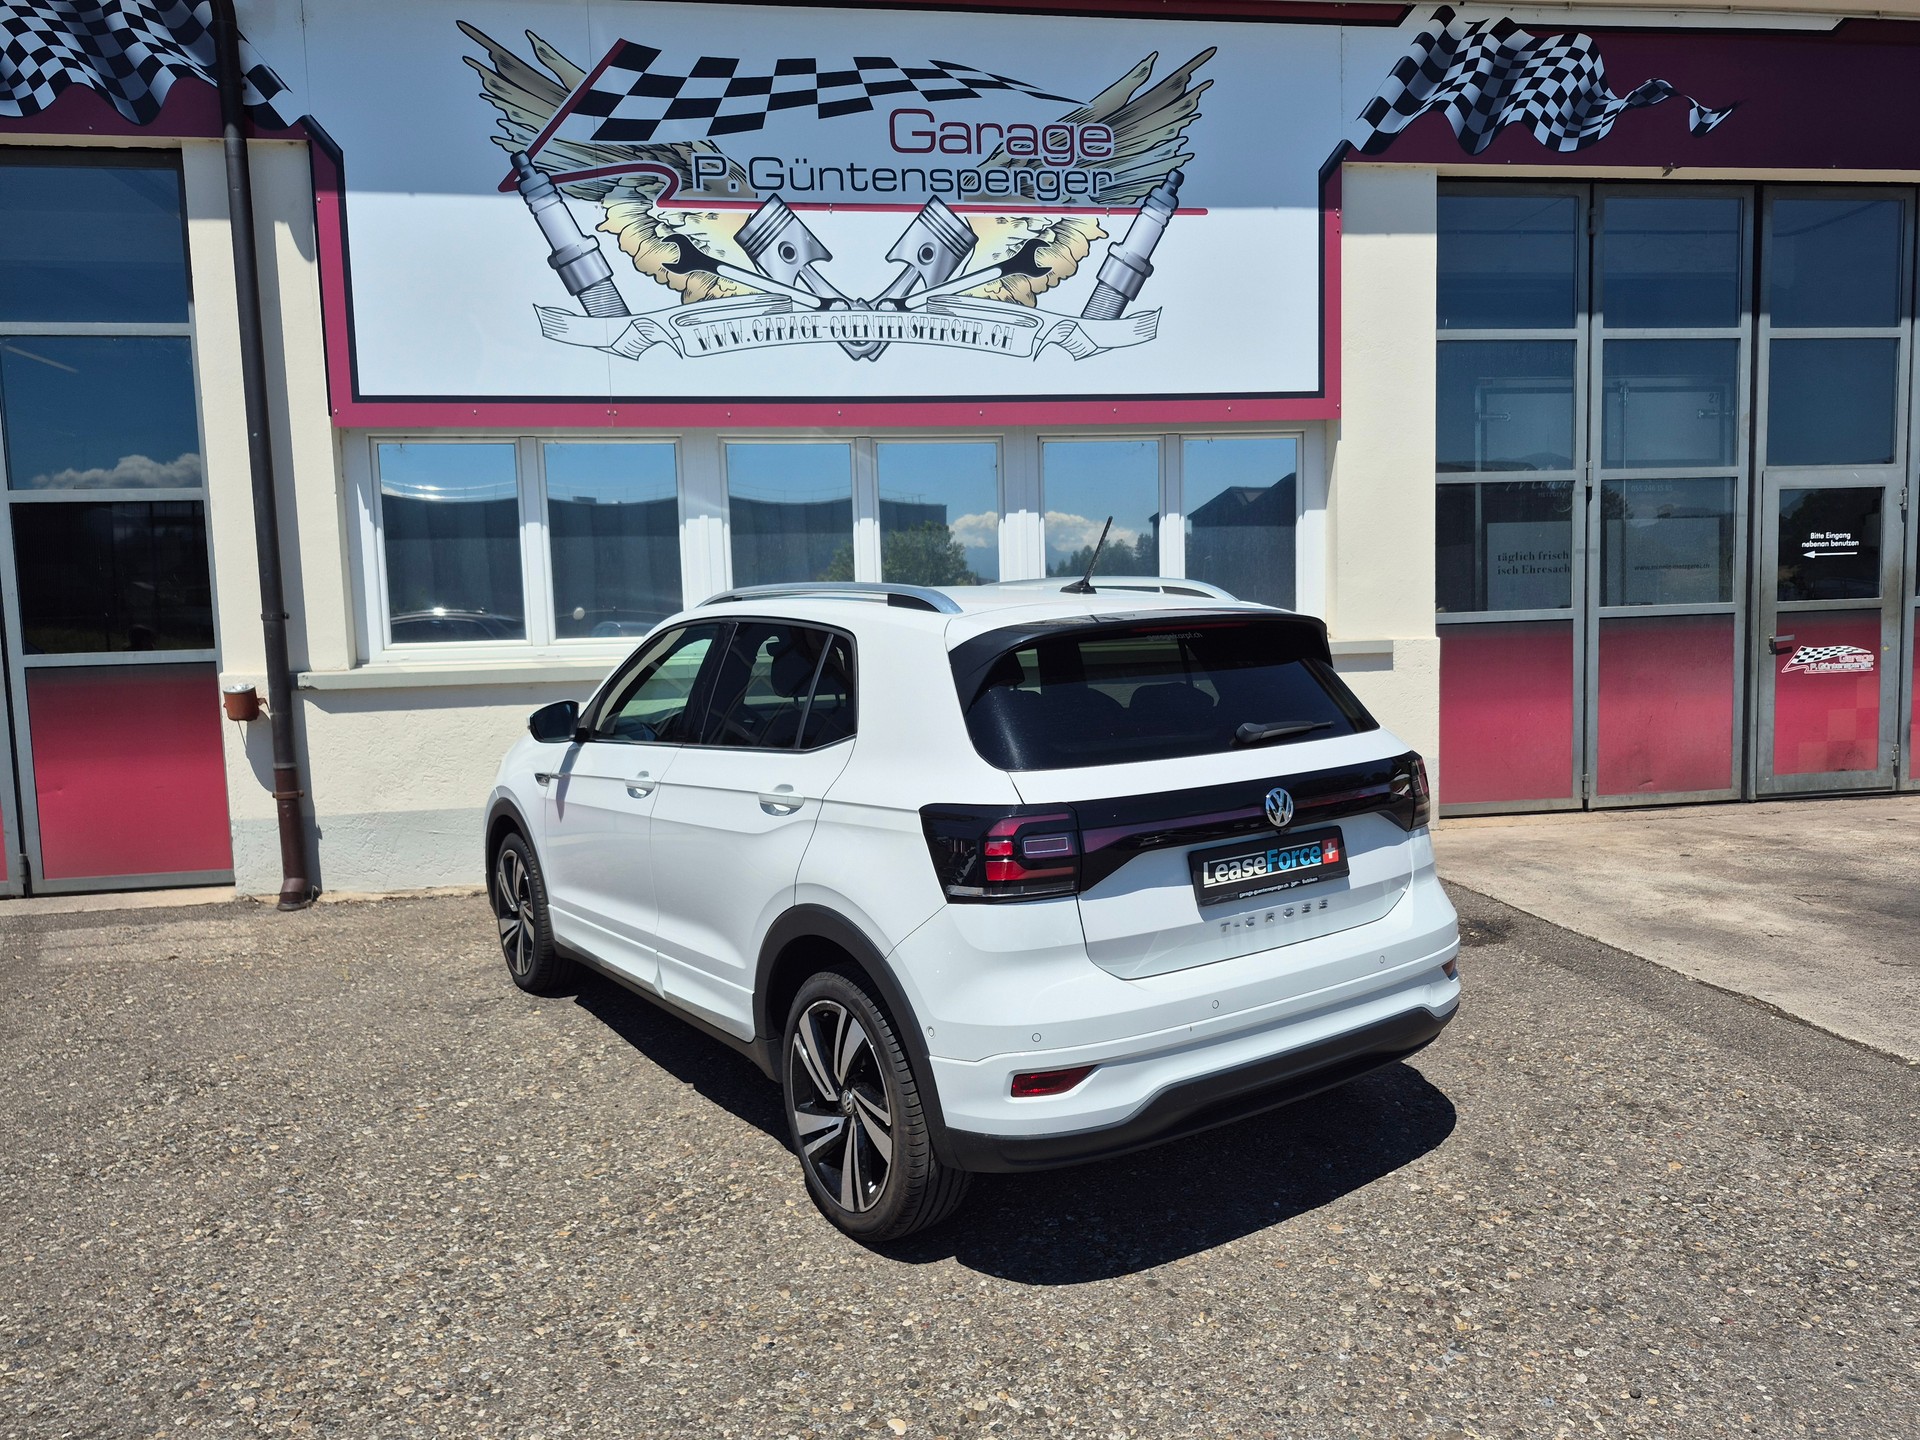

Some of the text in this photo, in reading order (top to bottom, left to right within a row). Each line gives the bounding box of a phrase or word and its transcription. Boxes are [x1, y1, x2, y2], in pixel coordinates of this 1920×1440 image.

[890, 108, 1113, 166] Garage
[749, 157, 1114, 200] Güntensperger
[693, 314, 1016, 351] WWW.GARAGE-GUENTENSPERGER.CH
[1826, 531, 1851, 540] Eingang
[1830, 539, 1860, 547] benutzen
[1538, 550, 1569, 560] frisch
[1203, 845, 1322, 886] LeaseForce
